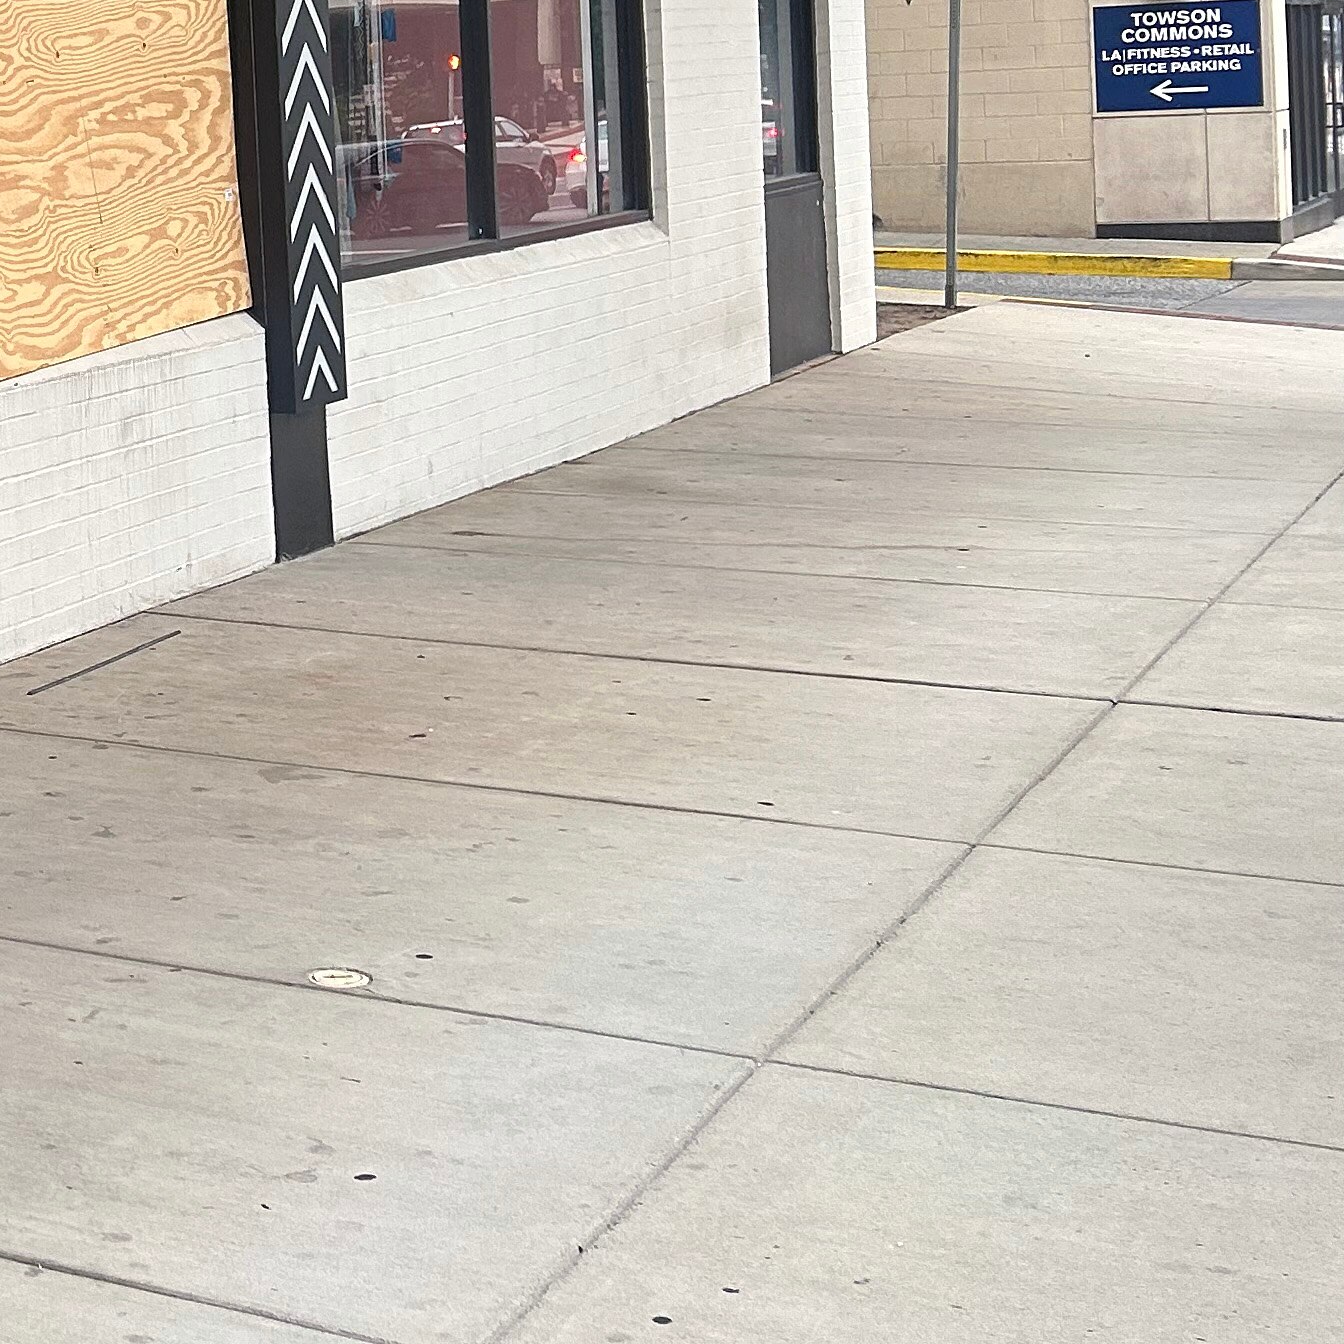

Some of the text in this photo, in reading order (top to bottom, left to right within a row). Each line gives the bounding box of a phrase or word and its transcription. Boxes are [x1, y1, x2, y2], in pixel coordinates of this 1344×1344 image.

[1130, 8, 1221, 27] TOWSON
[1121, 24, 1233, 43] COMMONS
[1201, 43, 1254, 56] RETAIL
[1112, 59, 1242, 76] OFFICE PARKING
